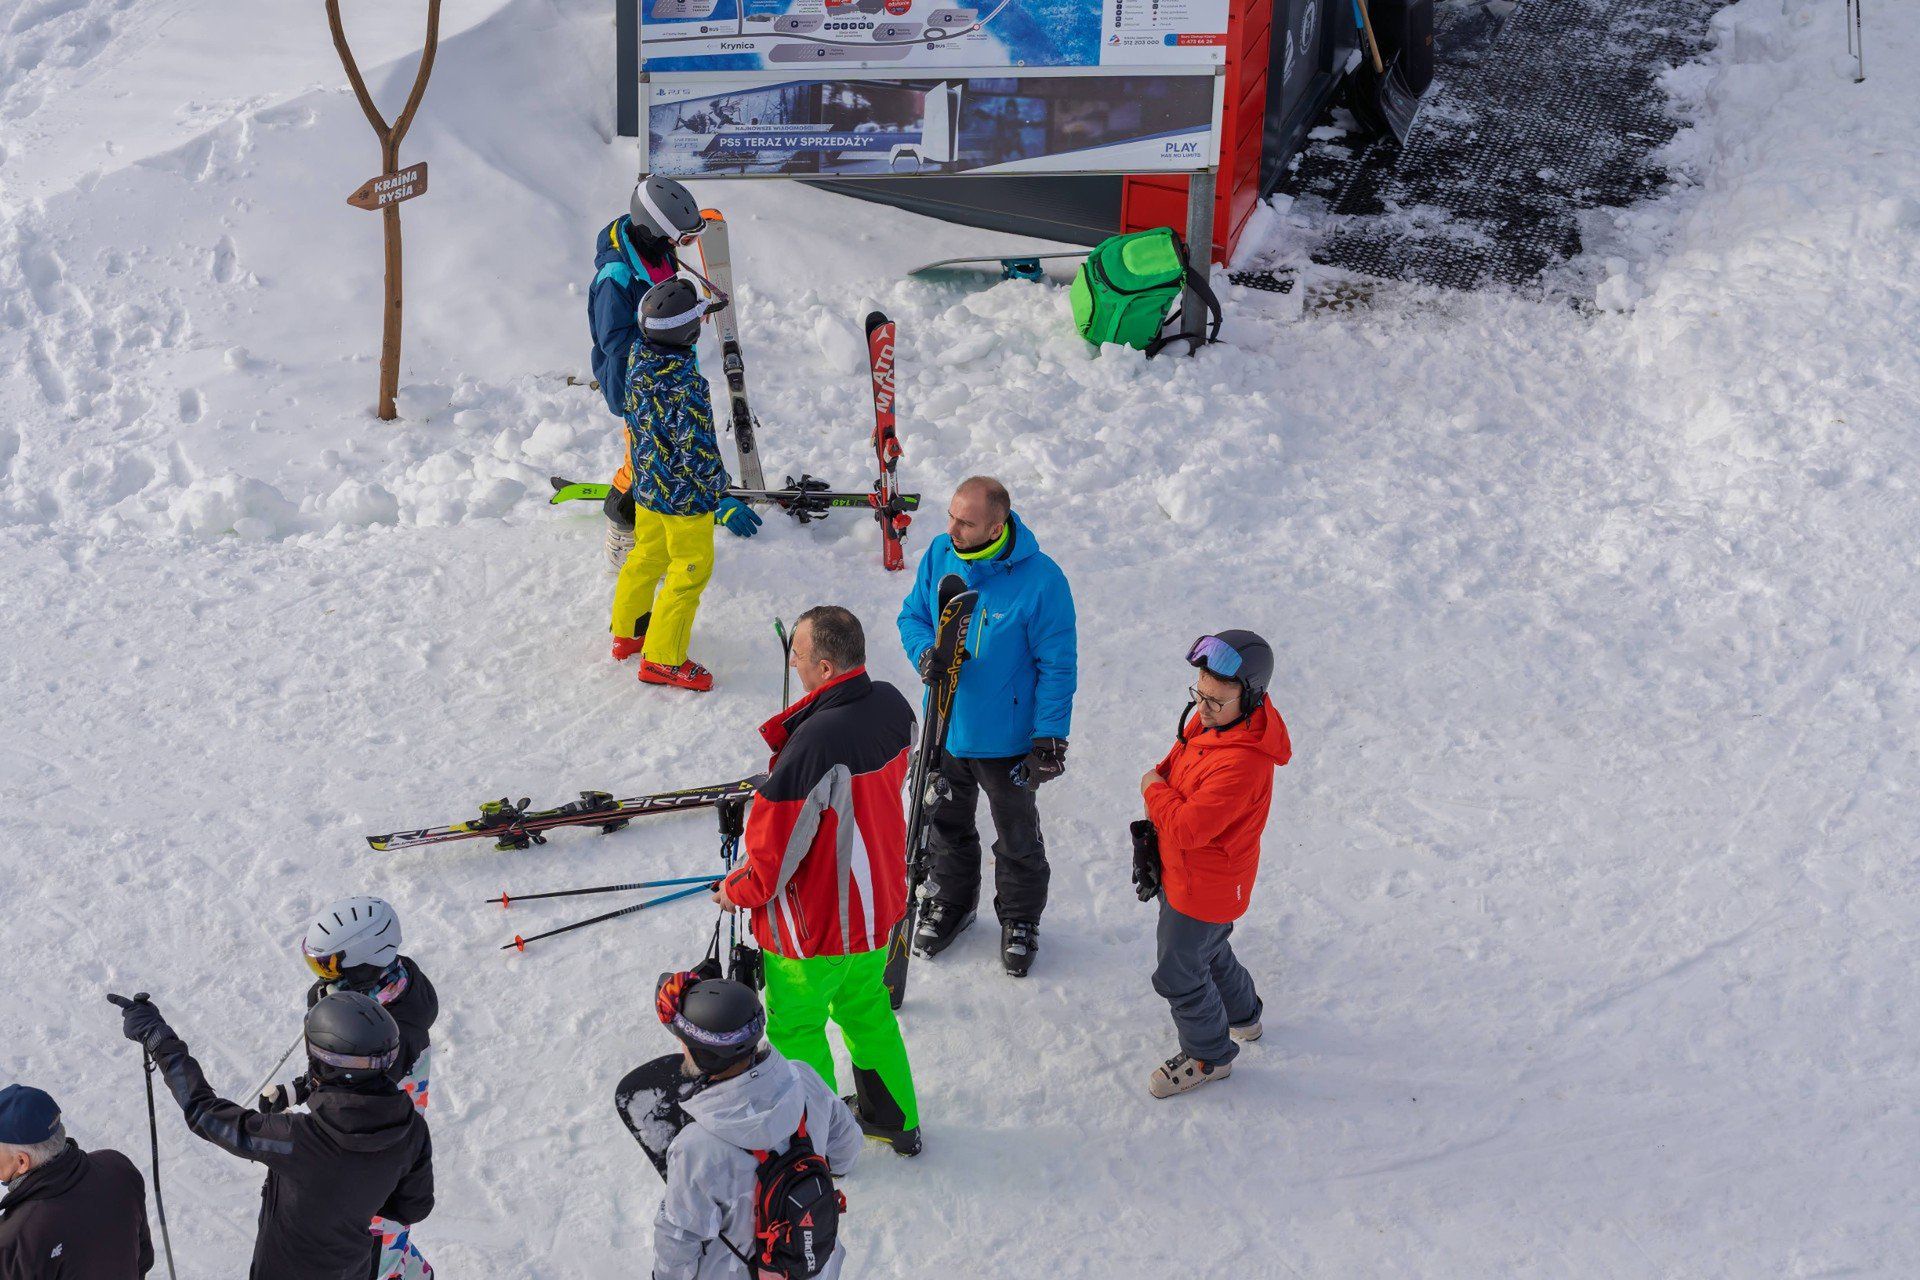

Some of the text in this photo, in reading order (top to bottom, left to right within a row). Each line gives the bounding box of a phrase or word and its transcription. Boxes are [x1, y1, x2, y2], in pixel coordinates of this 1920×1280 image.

[720, 42, 755, 51] Krynica
[720, 138, 741, 147] PS5
[744, 137, 782, 147] TERAZ
[784, 137, 798, 146] W
[1165, 143, 1198, 152] PLAY
[803, 1230, 816, 1273] DAINESE
